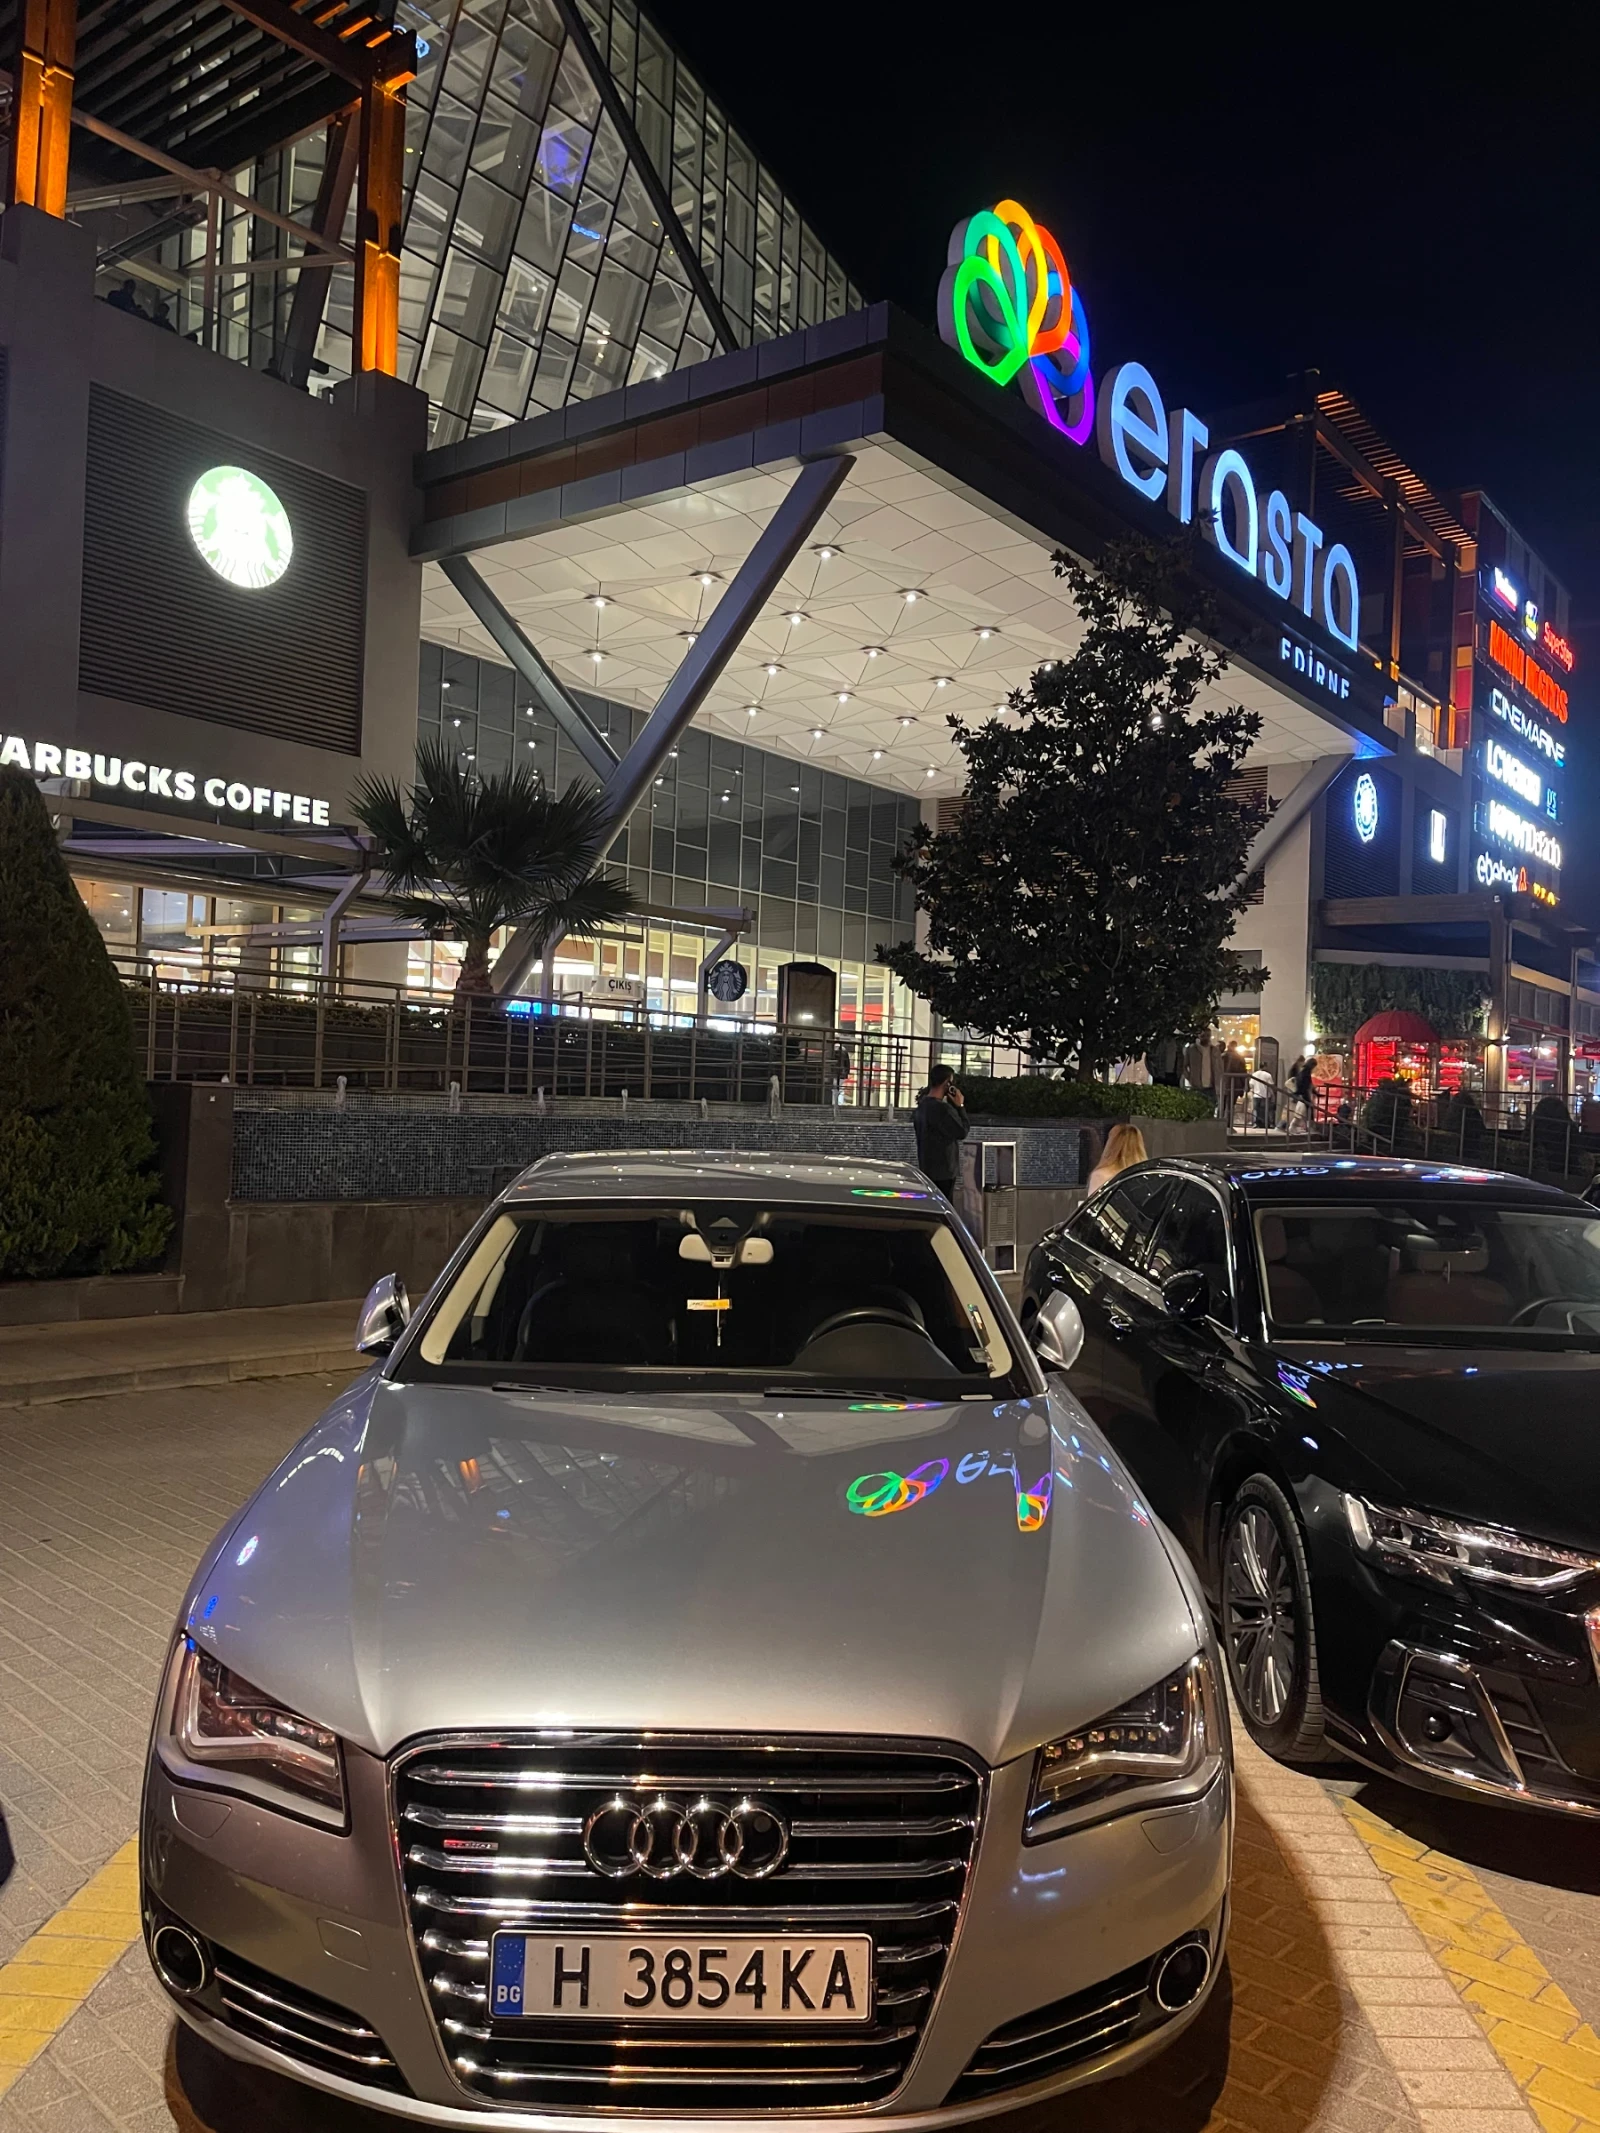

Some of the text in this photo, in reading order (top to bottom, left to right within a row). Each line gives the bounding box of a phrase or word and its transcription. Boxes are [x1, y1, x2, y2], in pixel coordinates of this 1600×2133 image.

[0, 734, 330, 826] ARBUCKS COFFEE
[608, 979, 632, 994] ÇIKIŞ
[496, 1985, 521, 2004] BG
[553, 1946, 590, 2008] H
